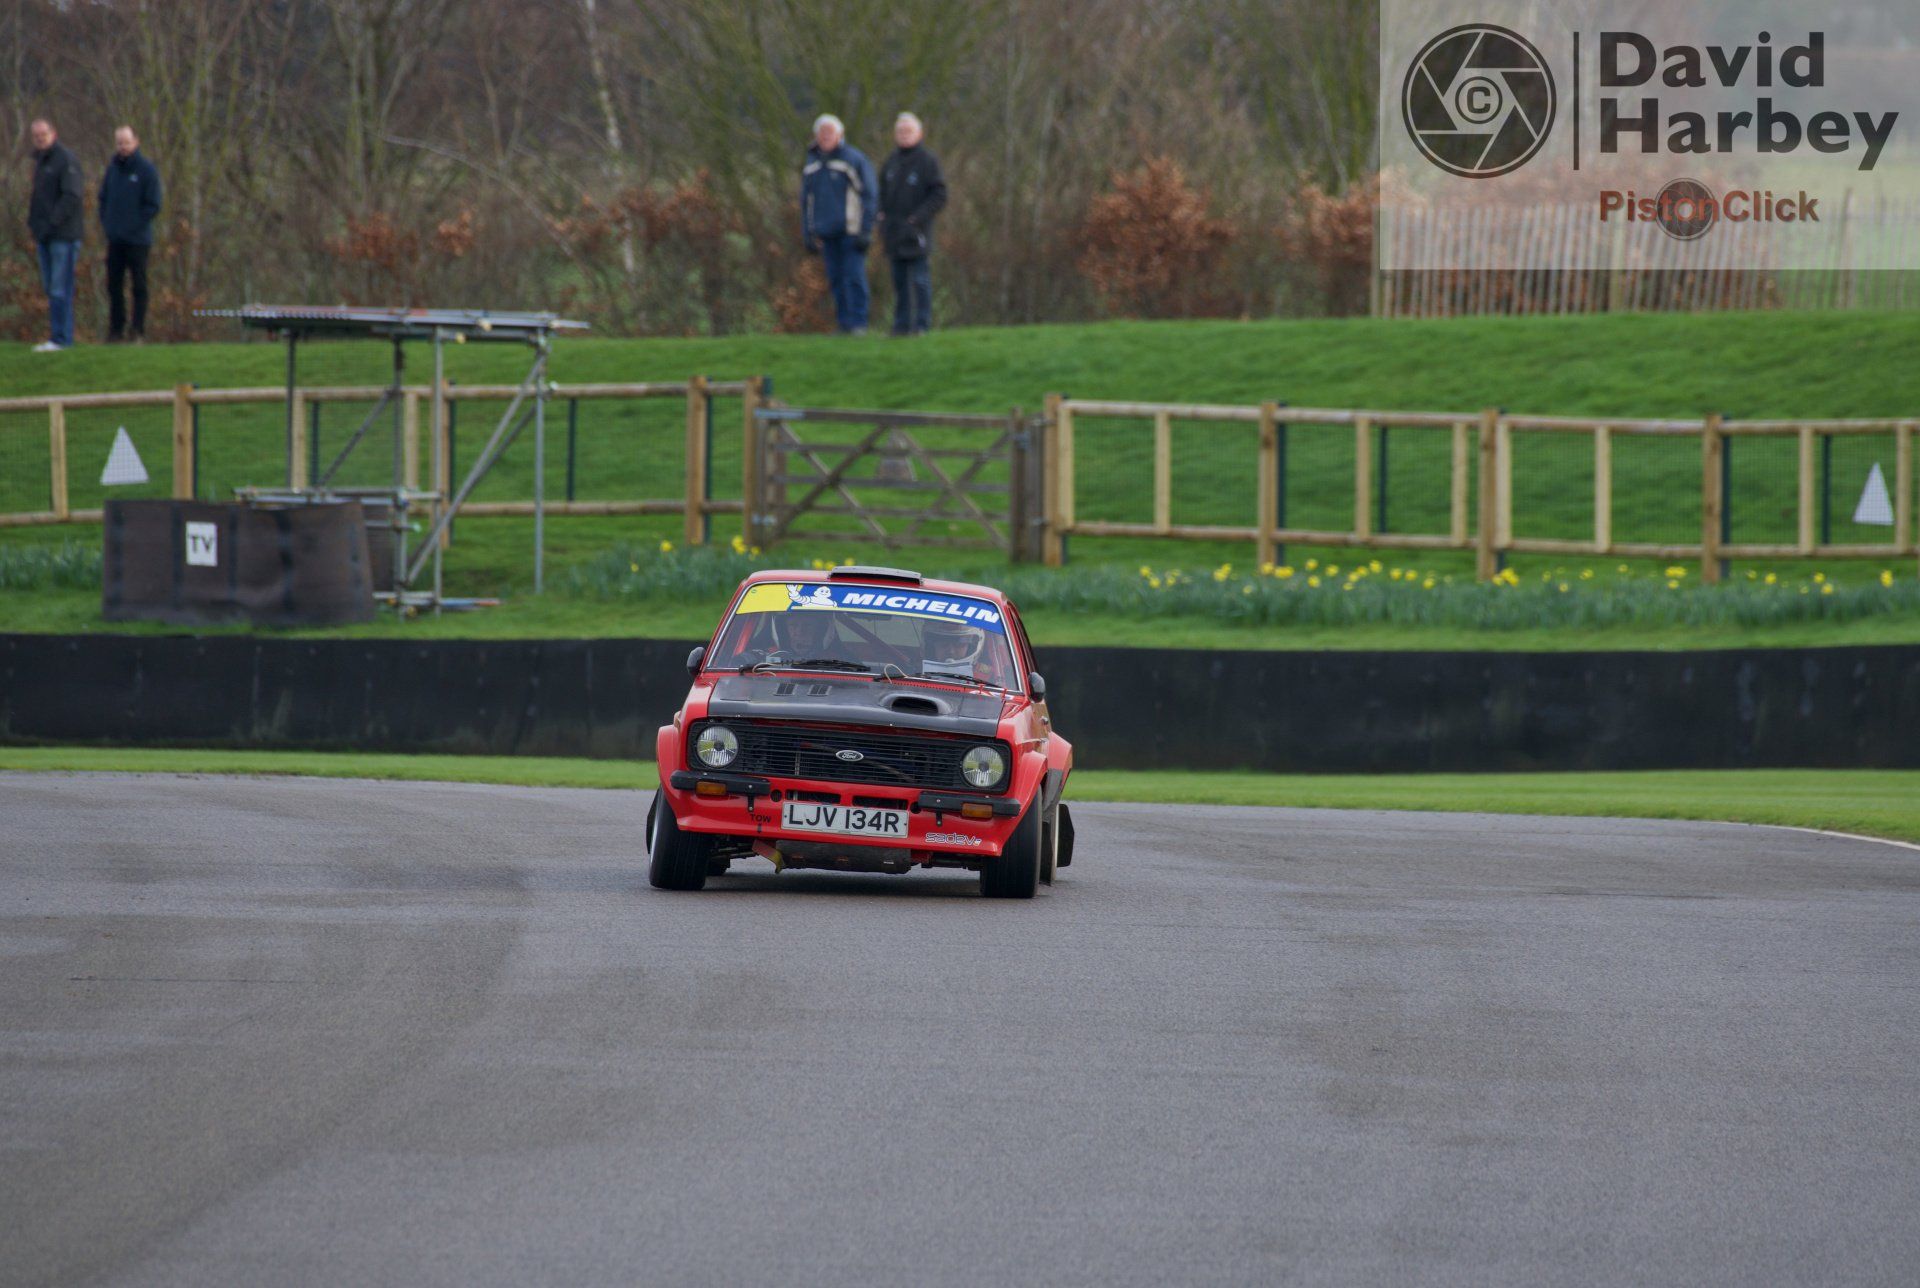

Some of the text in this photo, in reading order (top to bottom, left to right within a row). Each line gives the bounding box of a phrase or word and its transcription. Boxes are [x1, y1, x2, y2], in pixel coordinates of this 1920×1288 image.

[188, 534, 214, 553] TV
[842, 592, 1000, 624] MICHELIN
[750, 813, 772, 823] TOW
[788, 805, 900, 833] LJV 134R
